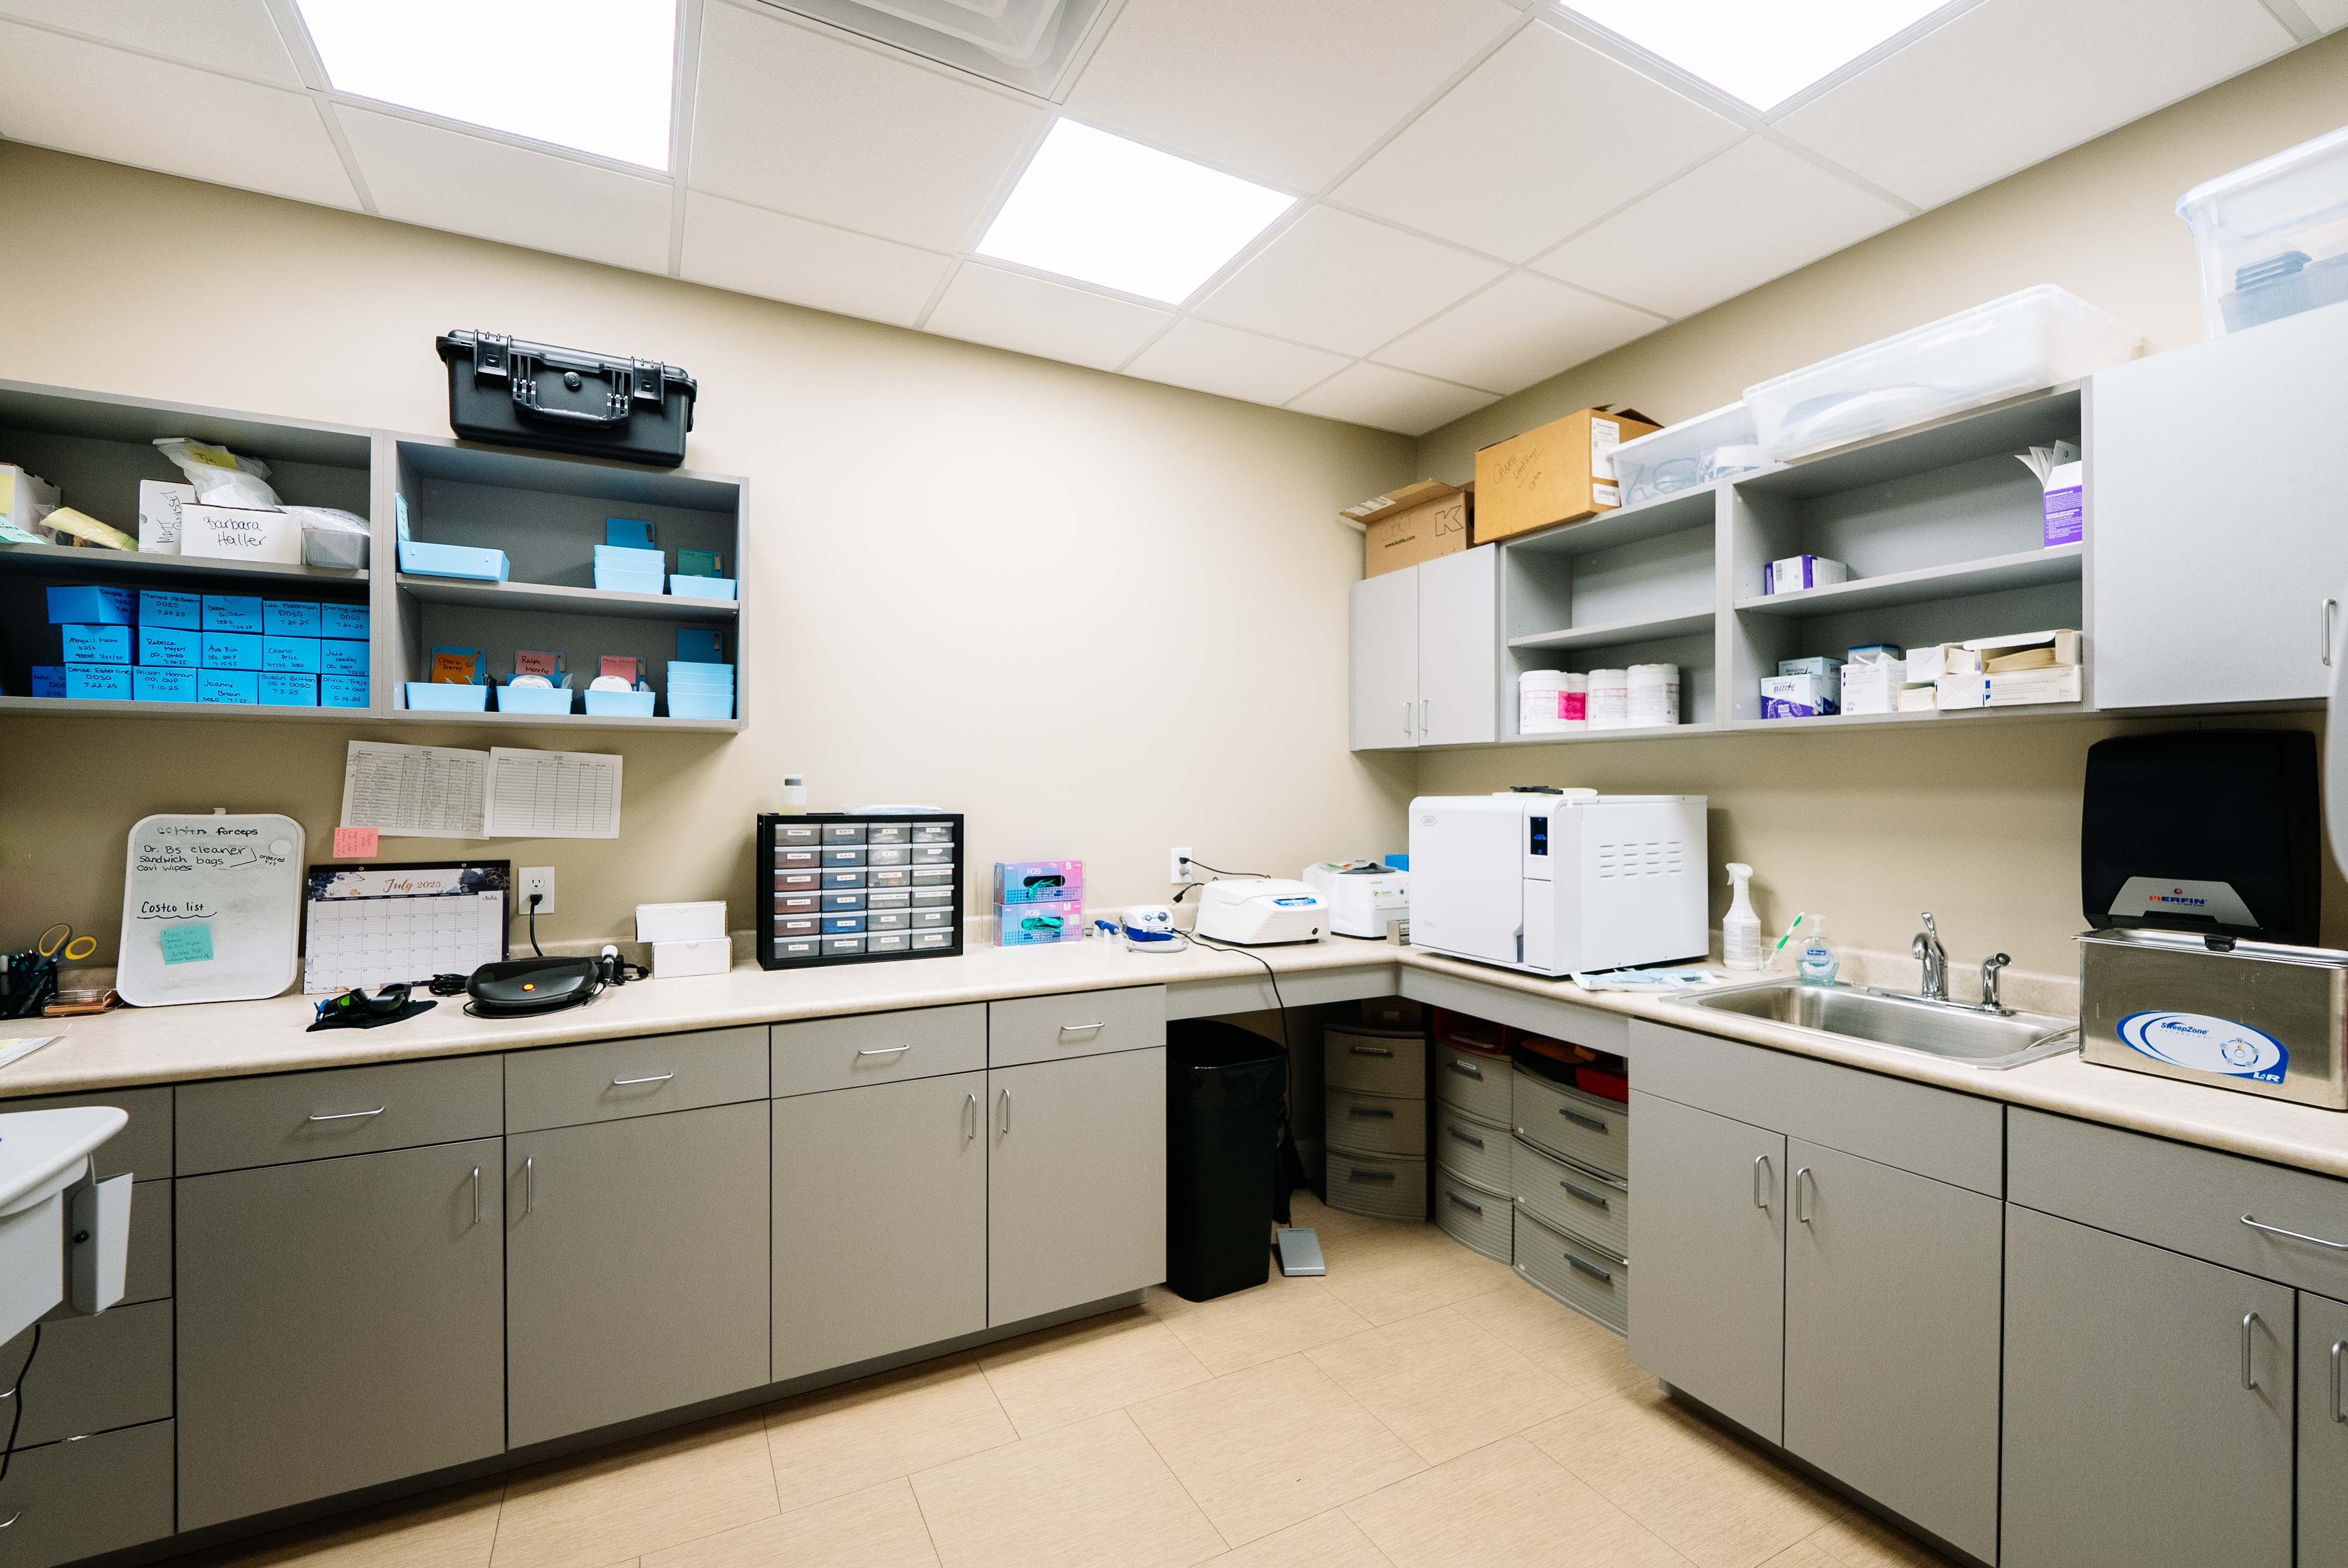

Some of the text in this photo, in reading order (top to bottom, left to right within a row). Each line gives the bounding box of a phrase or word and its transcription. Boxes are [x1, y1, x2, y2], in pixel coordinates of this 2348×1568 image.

[203, 516, 264, 532] Barbara
[1435, 505, 1464, 537] K
[217, 532, 267, 547] Haller
[208, 644, 222, 653] Ava
[521, 655, 542, 665] Ralph
[203, 679, 234, 688] Joanne
[215, 827, 259, 837] forceps
[191, 845, 246, 855] cleaner
[196, 857, 224, 867] bags
[383, 878, 414, 894] July
[141, 901, 204, 913] Costco list
[2161, 1022, 2207, 1035] SweepZone
